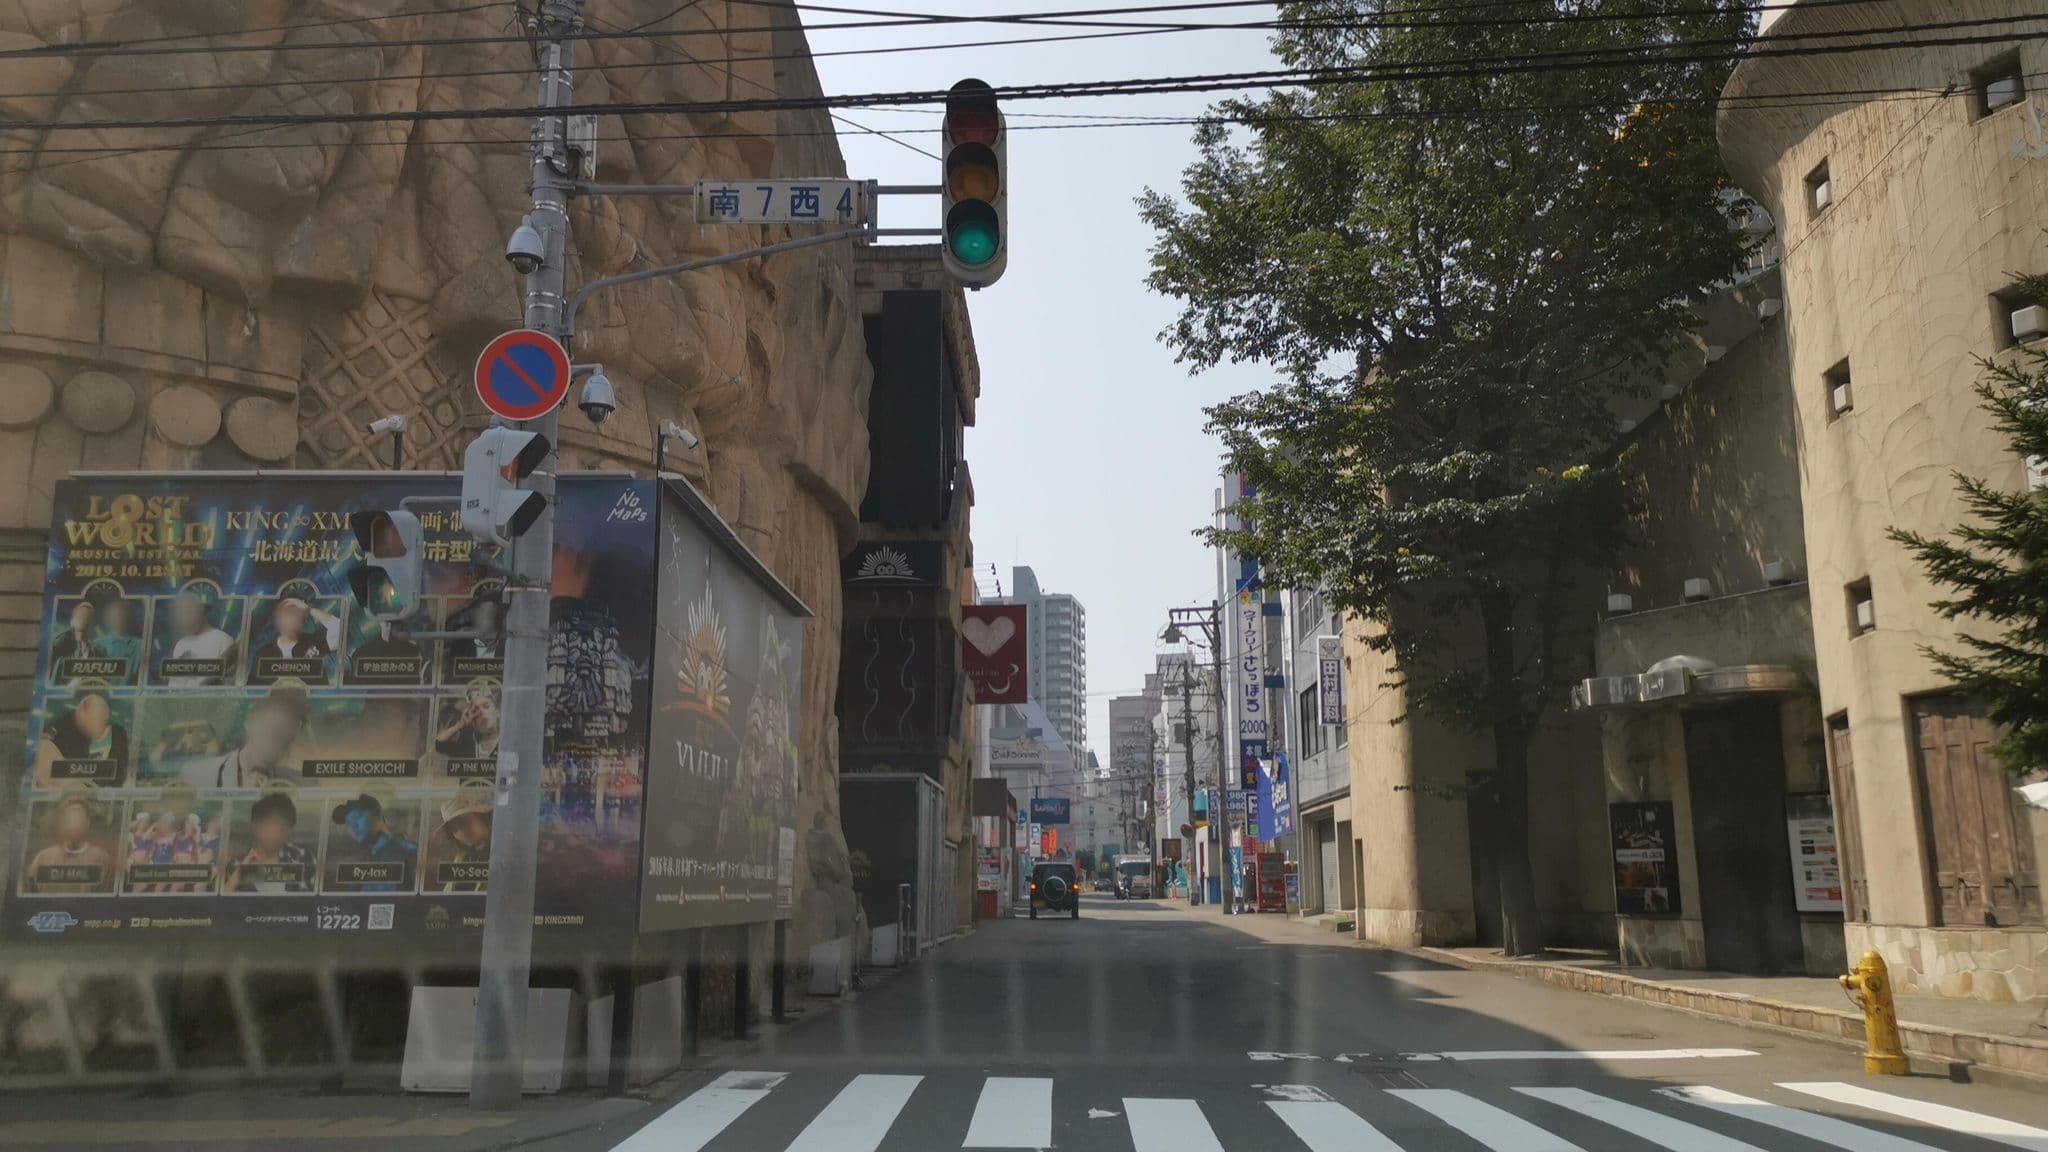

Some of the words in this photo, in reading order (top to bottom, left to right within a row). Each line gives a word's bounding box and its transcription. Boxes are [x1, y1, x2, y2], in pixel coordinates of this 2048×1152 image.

[709, 186, 853, 218] 南7西4
[616, 488, 641, 507] No
[68, 549, 121, 560] MUSIC
[1241, 719, 1265, 734] 2000
[69, 763, 98, 775] SALU
[315, 763, 345, 775] EXILE
[348, 763, 406, 775] SHOKICHI
[315, 914, 361, 930] 12722
